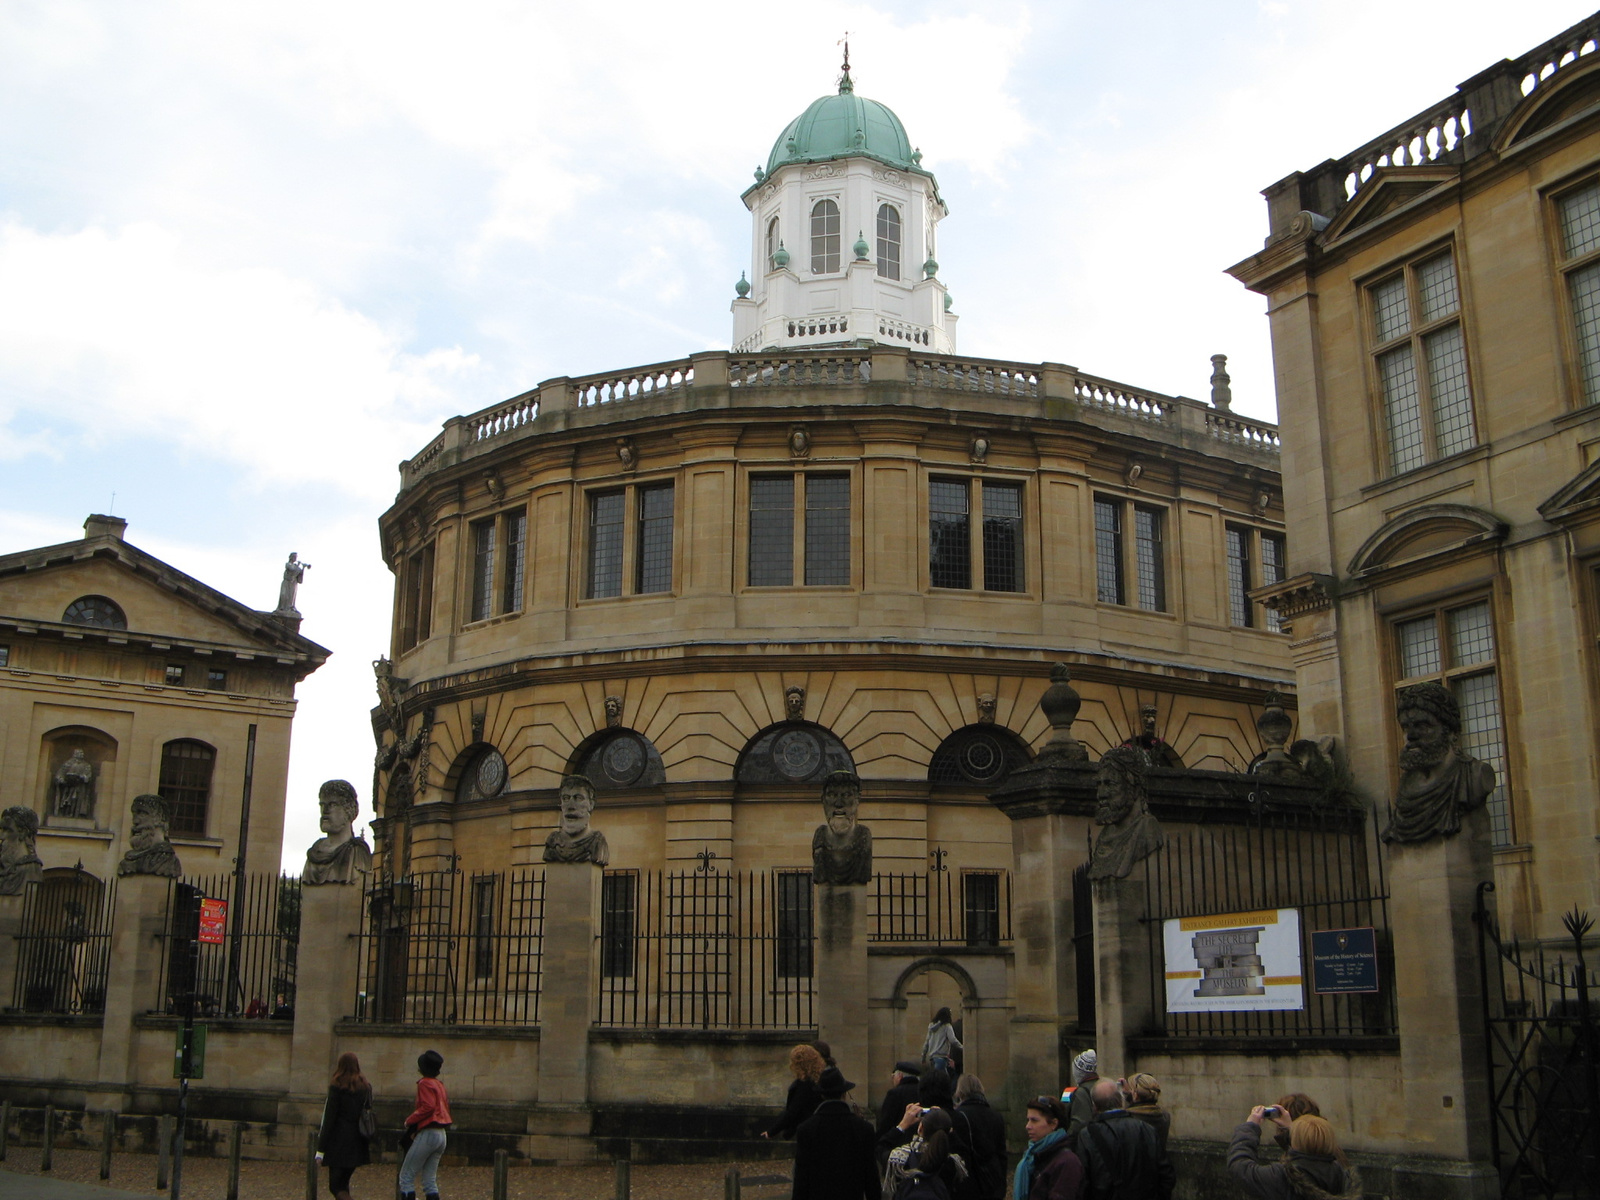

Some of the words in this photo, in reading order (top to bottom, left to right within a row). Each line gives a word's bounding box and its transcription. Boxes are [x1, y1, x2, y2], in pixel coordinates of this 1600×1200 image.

[1183, 920, 1212, 929] ENTRANCE
[1213, 918, 1237, 927] GALLERY
[1239, 915, 1274, 925] EXHIBITION
[1201, 936, 1215, 946] THE
[1218, 933, 1249, 945] SECRET
[1218, 945, 1233, 955] LIFE
[1222, 968, 1234, 977] THE
[1213, 978, 1249, 989] MUSEUM
